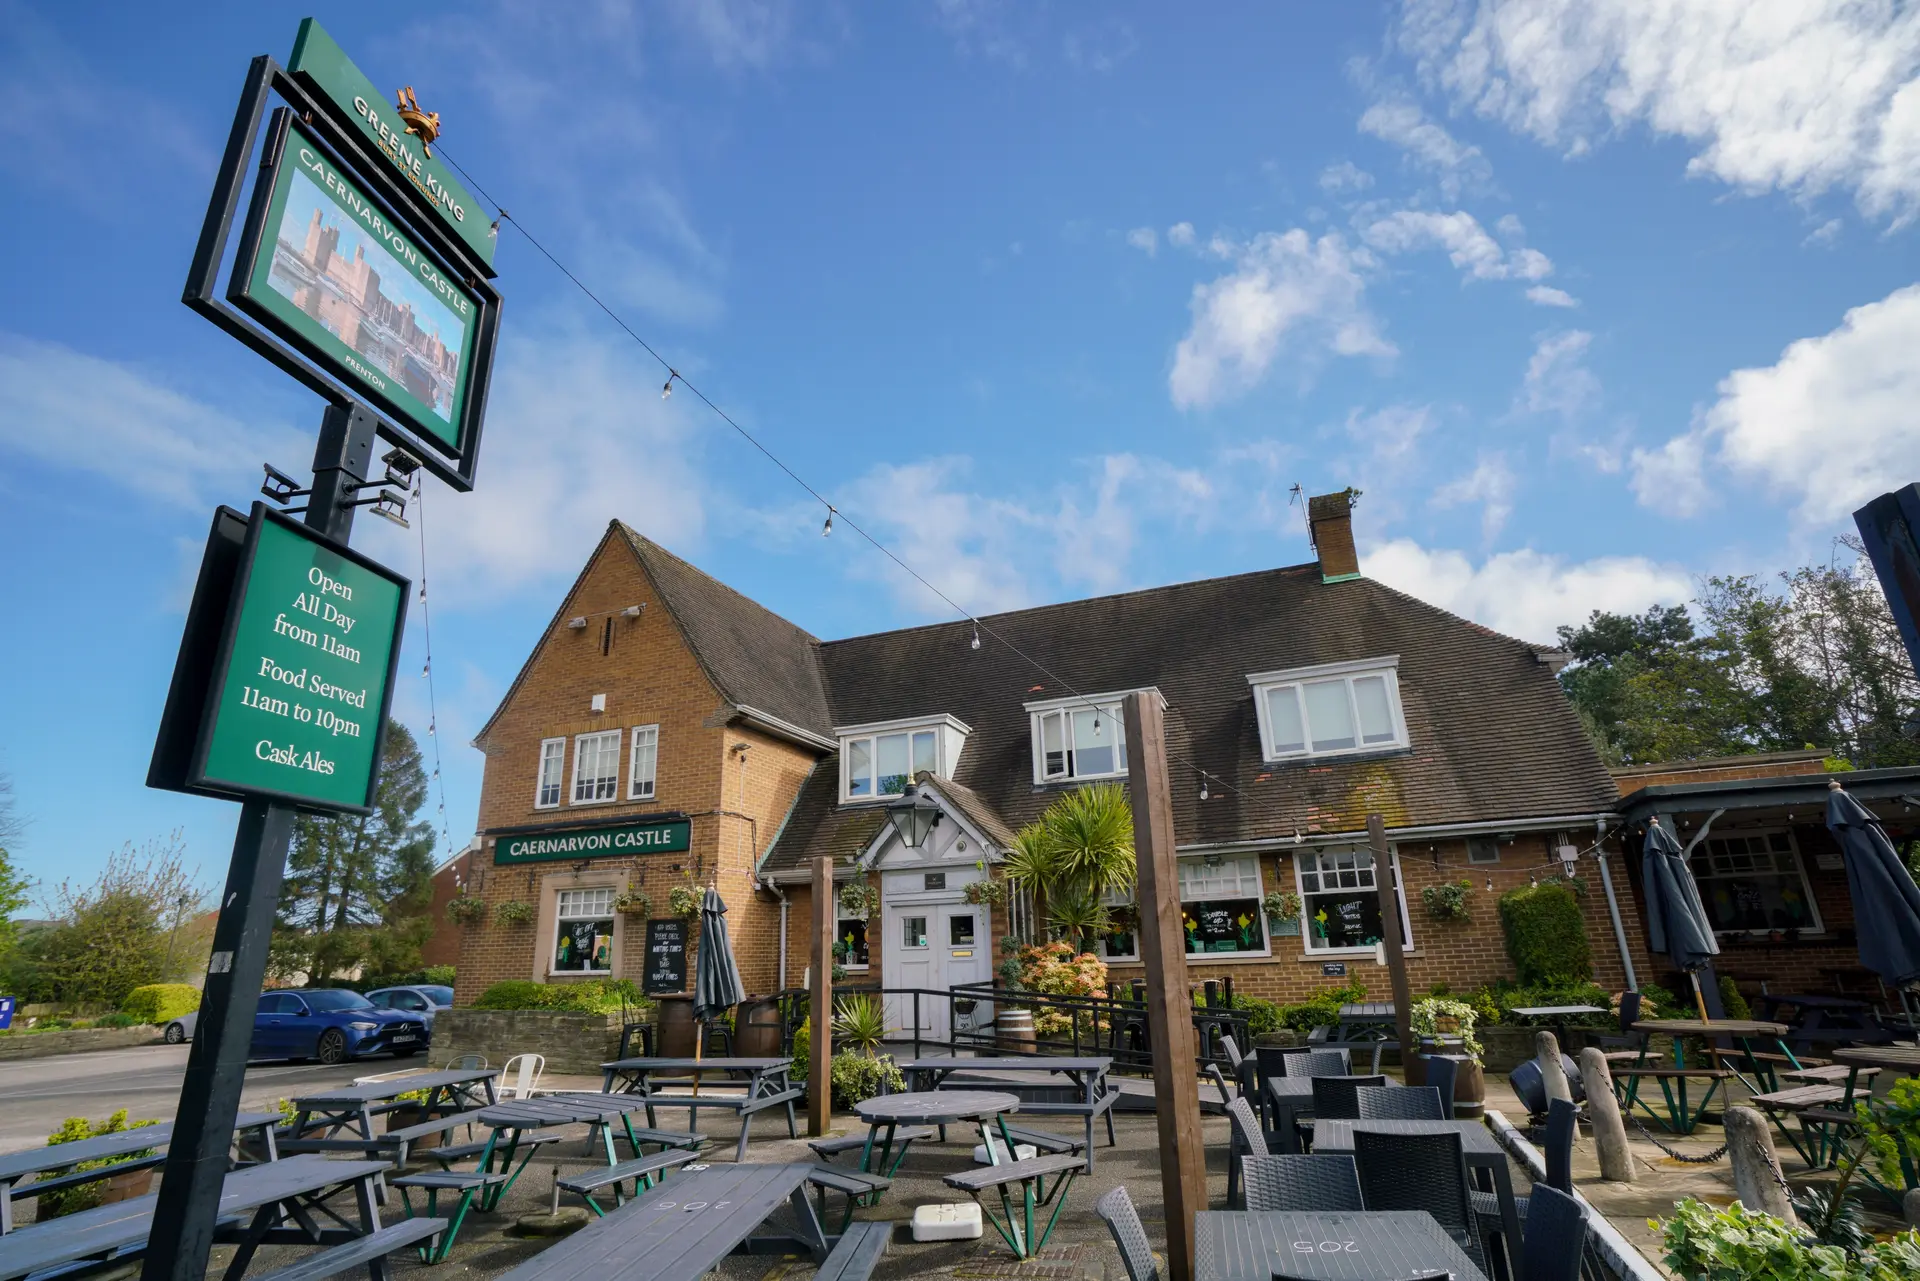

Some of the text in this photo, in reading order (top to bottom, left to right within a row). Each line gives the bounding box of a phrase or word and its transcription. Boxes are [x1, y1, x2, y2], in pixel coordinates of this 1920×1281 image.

[353, 96, 465, 222] GREENE KING
[378, 140, 440, 207] BURY ST EDMUNDS
[300, 148, 468, 315] CAERNARVON CASTLE
[345, 355, 386, 390] PRENTON
[308, 567, 353, 601] Open
[292, 592, 356, 634] All Day
[272, 613, 361, 664] from 11am
[257, 656, 366, 708] Food Served
[240, 686, 360, 737] 11am to 10pm
[255, 740, 335, 775] Cask Ales
[509, 829, 672, 857] CAERNARVON CASTLE
[1338, 900, 1363, 915] LIGHT
[653, 1201, 731, 1210] 206
[1293, 1241, 1359, 1253] 205
